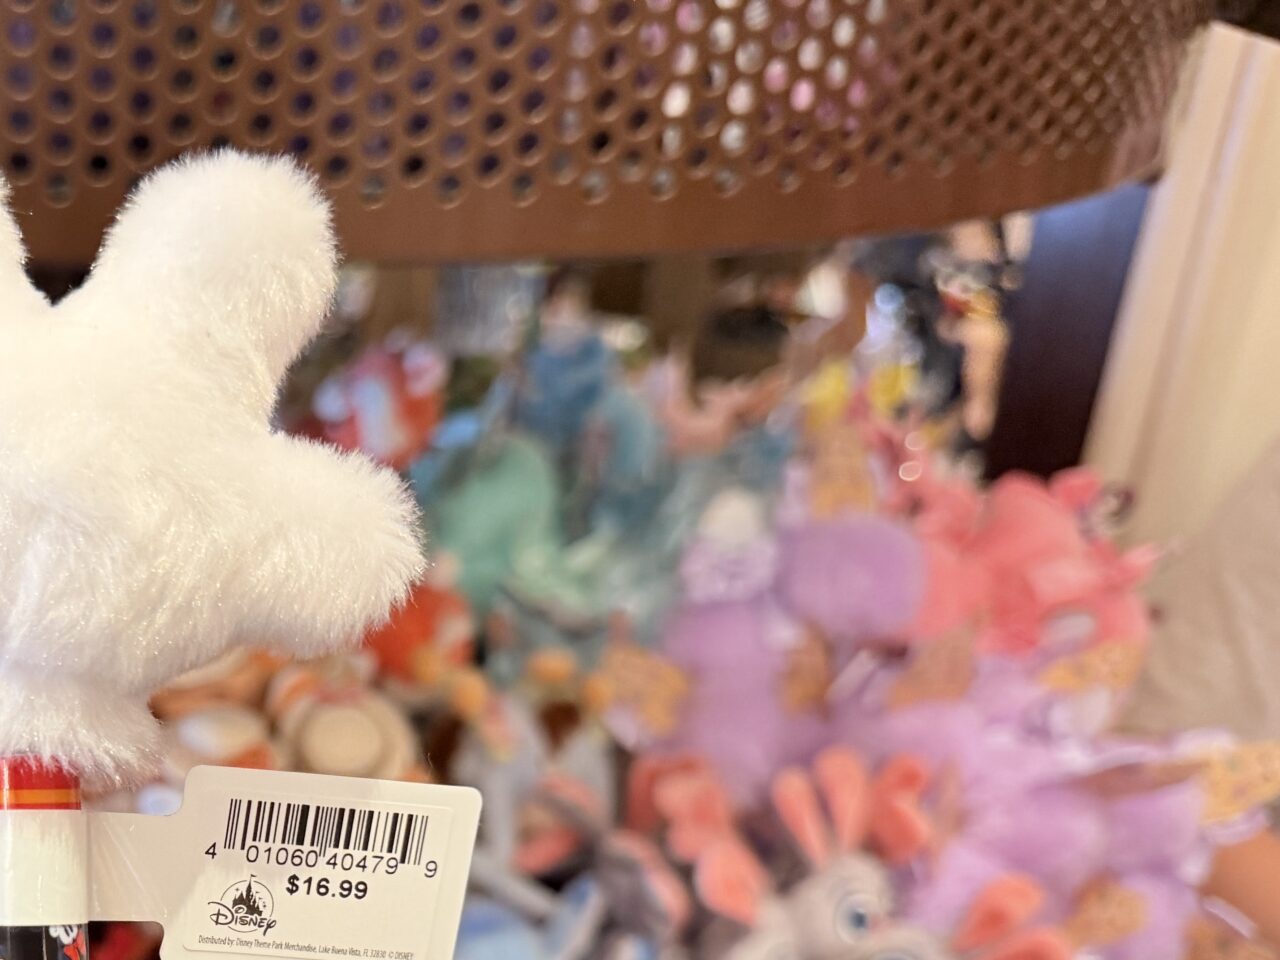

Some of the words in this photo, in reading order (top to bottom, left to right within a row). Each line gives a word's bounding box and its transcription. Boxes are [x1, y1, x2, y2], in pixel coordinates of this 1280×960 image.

[204, 842, 217, 860] 4
[245, 845, 319, 868] 01060
[326, 853, 399, 875] 40479
[424, 861, 438, 878] 9
[285, 874, 368, 900] $16.99
[198, 934, 227, 946] Distributed
[227, 936, 235, 948] by:
[236, 938, 253, 949] Disney
[254, 939, 271, 949] Theme
[272, 941, 283, 950] Park
[284, 941, 317, 953] Merchandise,
[318, 944, 331, 954] Lake
[331, 946, 348, 956] Buena
[348, 947, 362, 957] Vista,
[363, 948, 370, 958] FL
